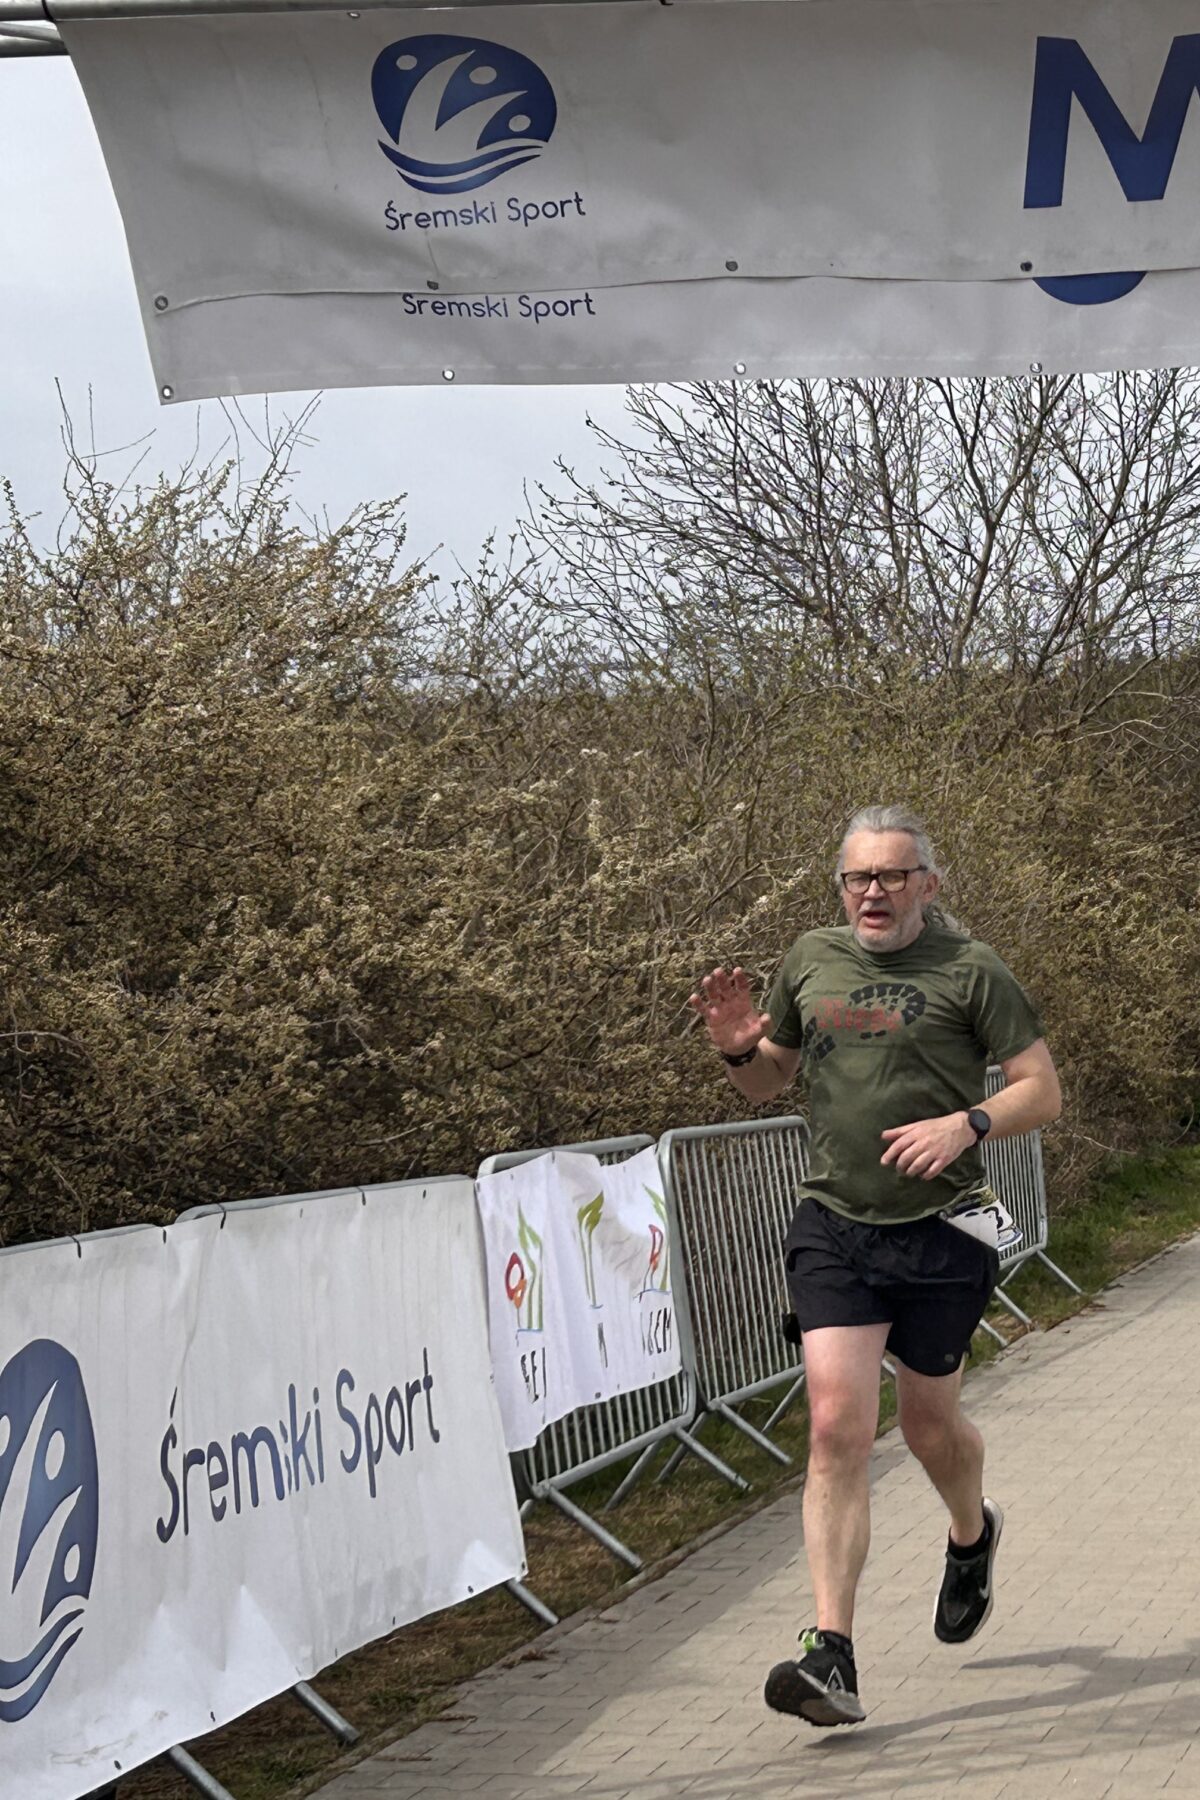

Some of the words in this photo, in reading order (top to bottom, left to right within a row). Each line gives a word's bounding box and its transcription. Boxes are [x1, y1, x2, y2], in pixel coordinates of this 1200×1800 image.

[384, 200, 498, 231] Śremski
[506, 191, 587, 228] Sport
[517, 292, 597, 325] Sport
[335, 1346, 441, 1499] Sport
